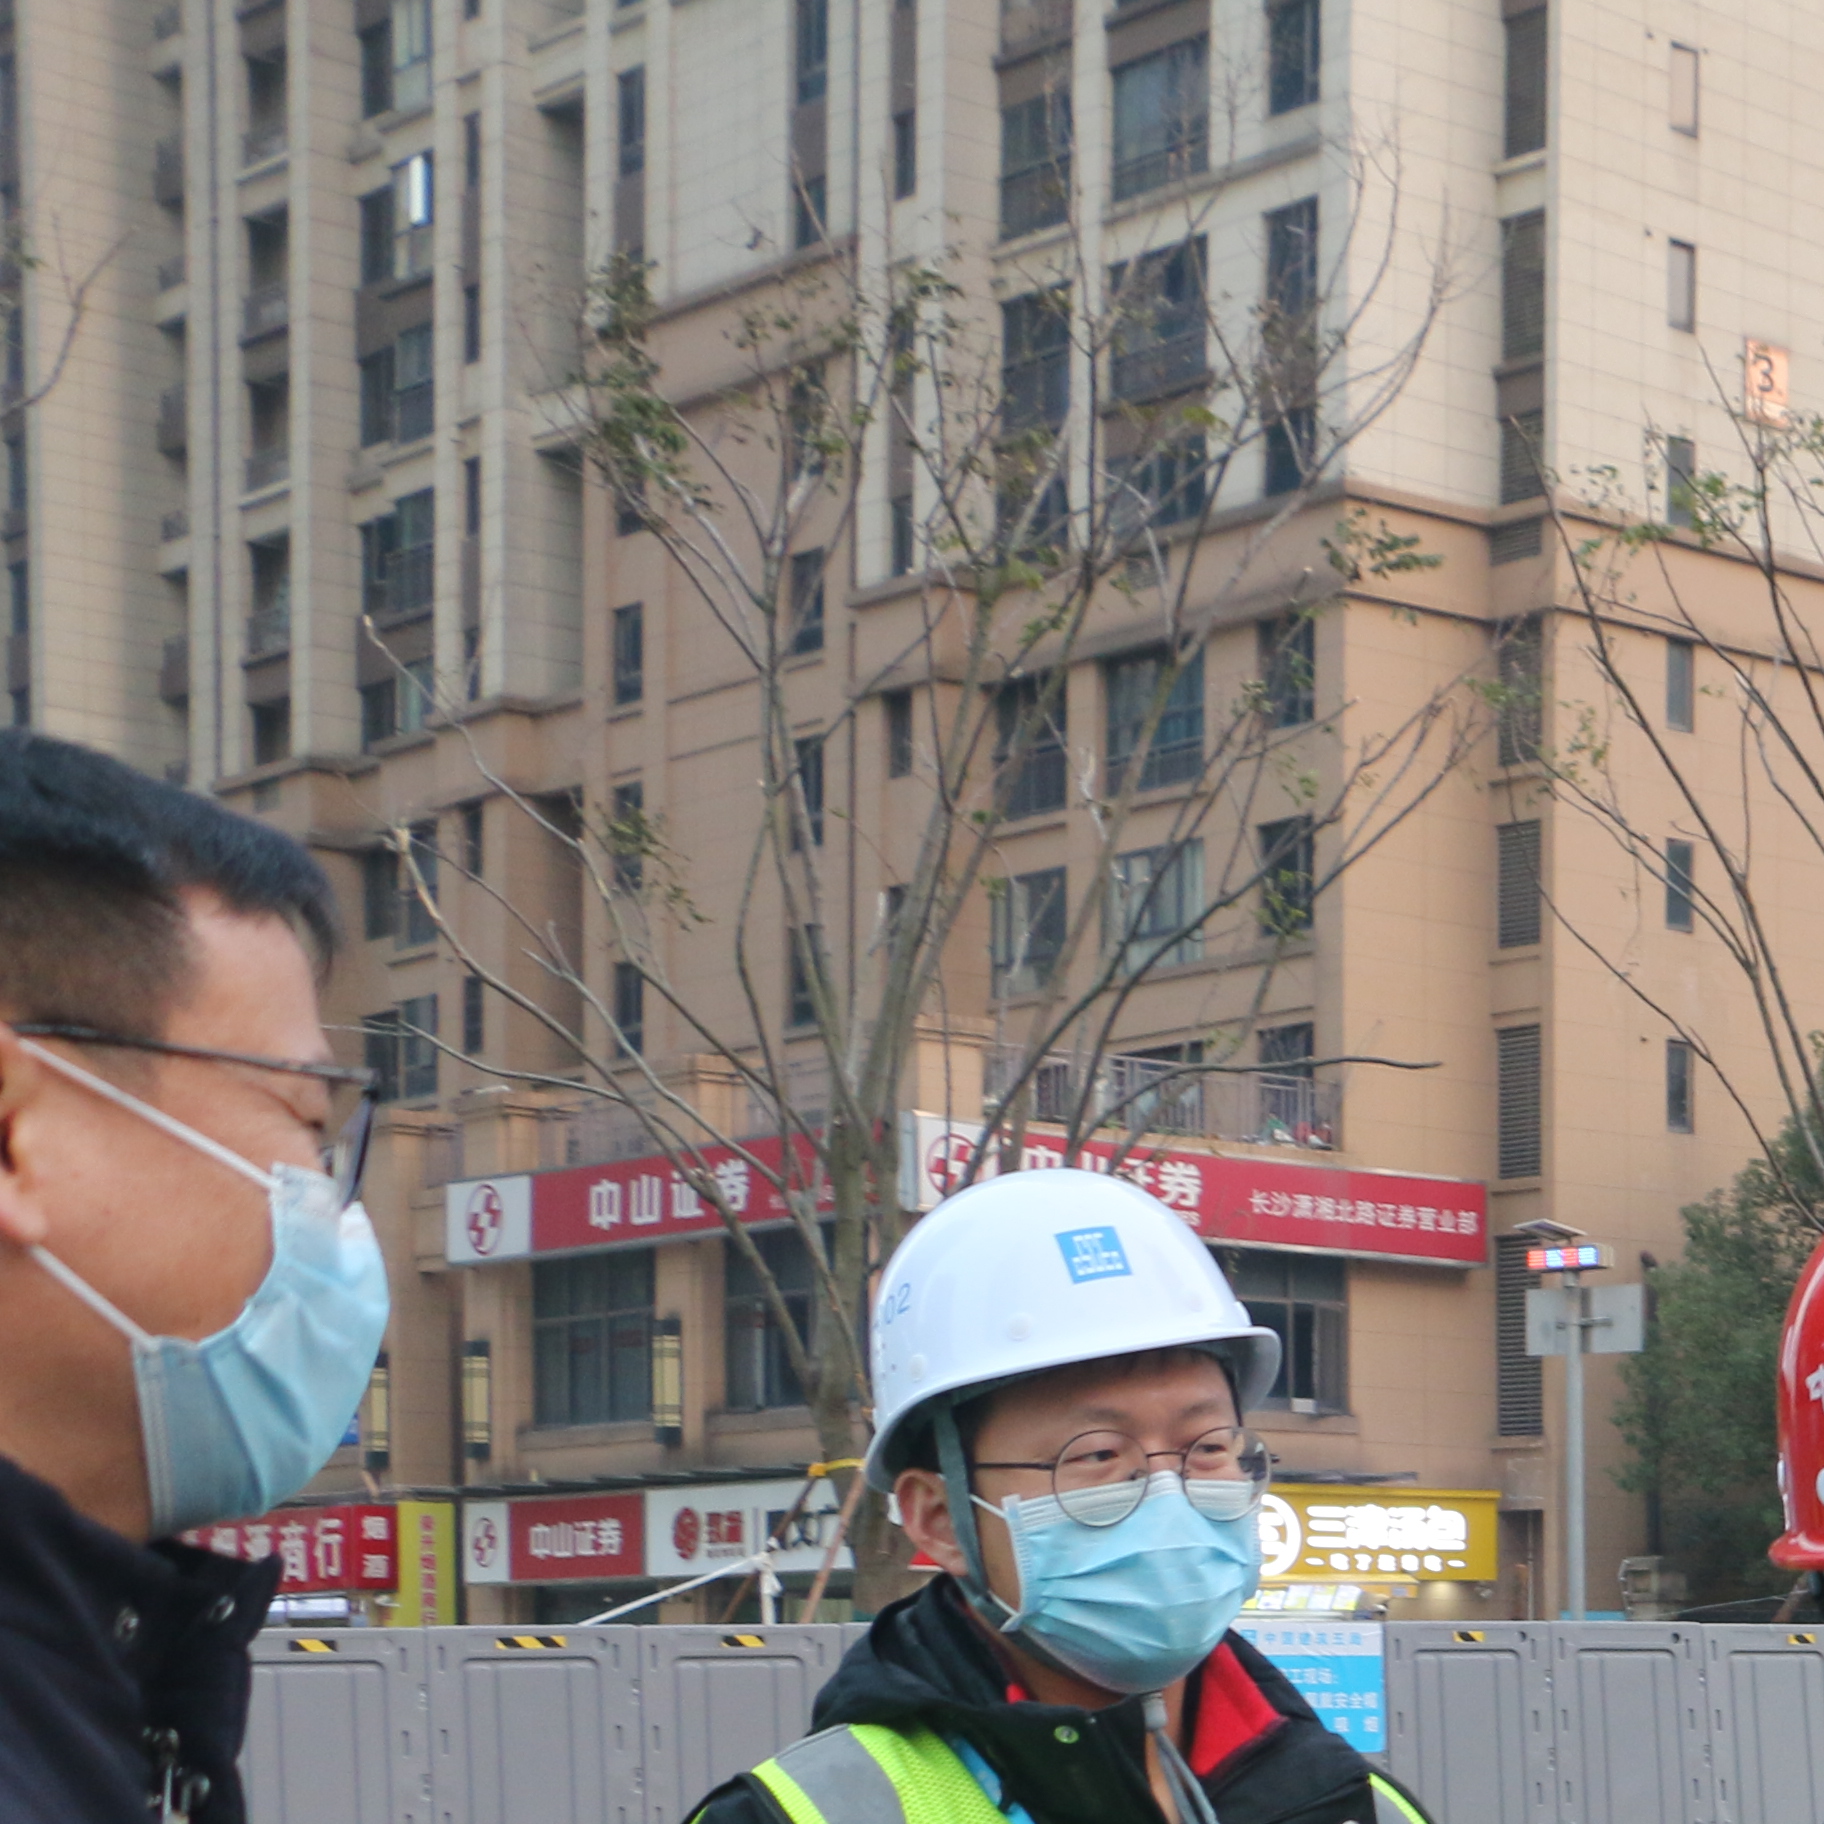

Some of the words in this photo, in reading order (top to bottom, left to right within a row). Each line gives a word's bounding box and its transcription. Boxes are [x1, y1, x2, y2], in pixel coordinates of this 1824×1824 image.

[1248, 1188, 1478, 1236] 长沙潇湘北路证券营业部
[529, 1517, 622, 1559] 中山证券
